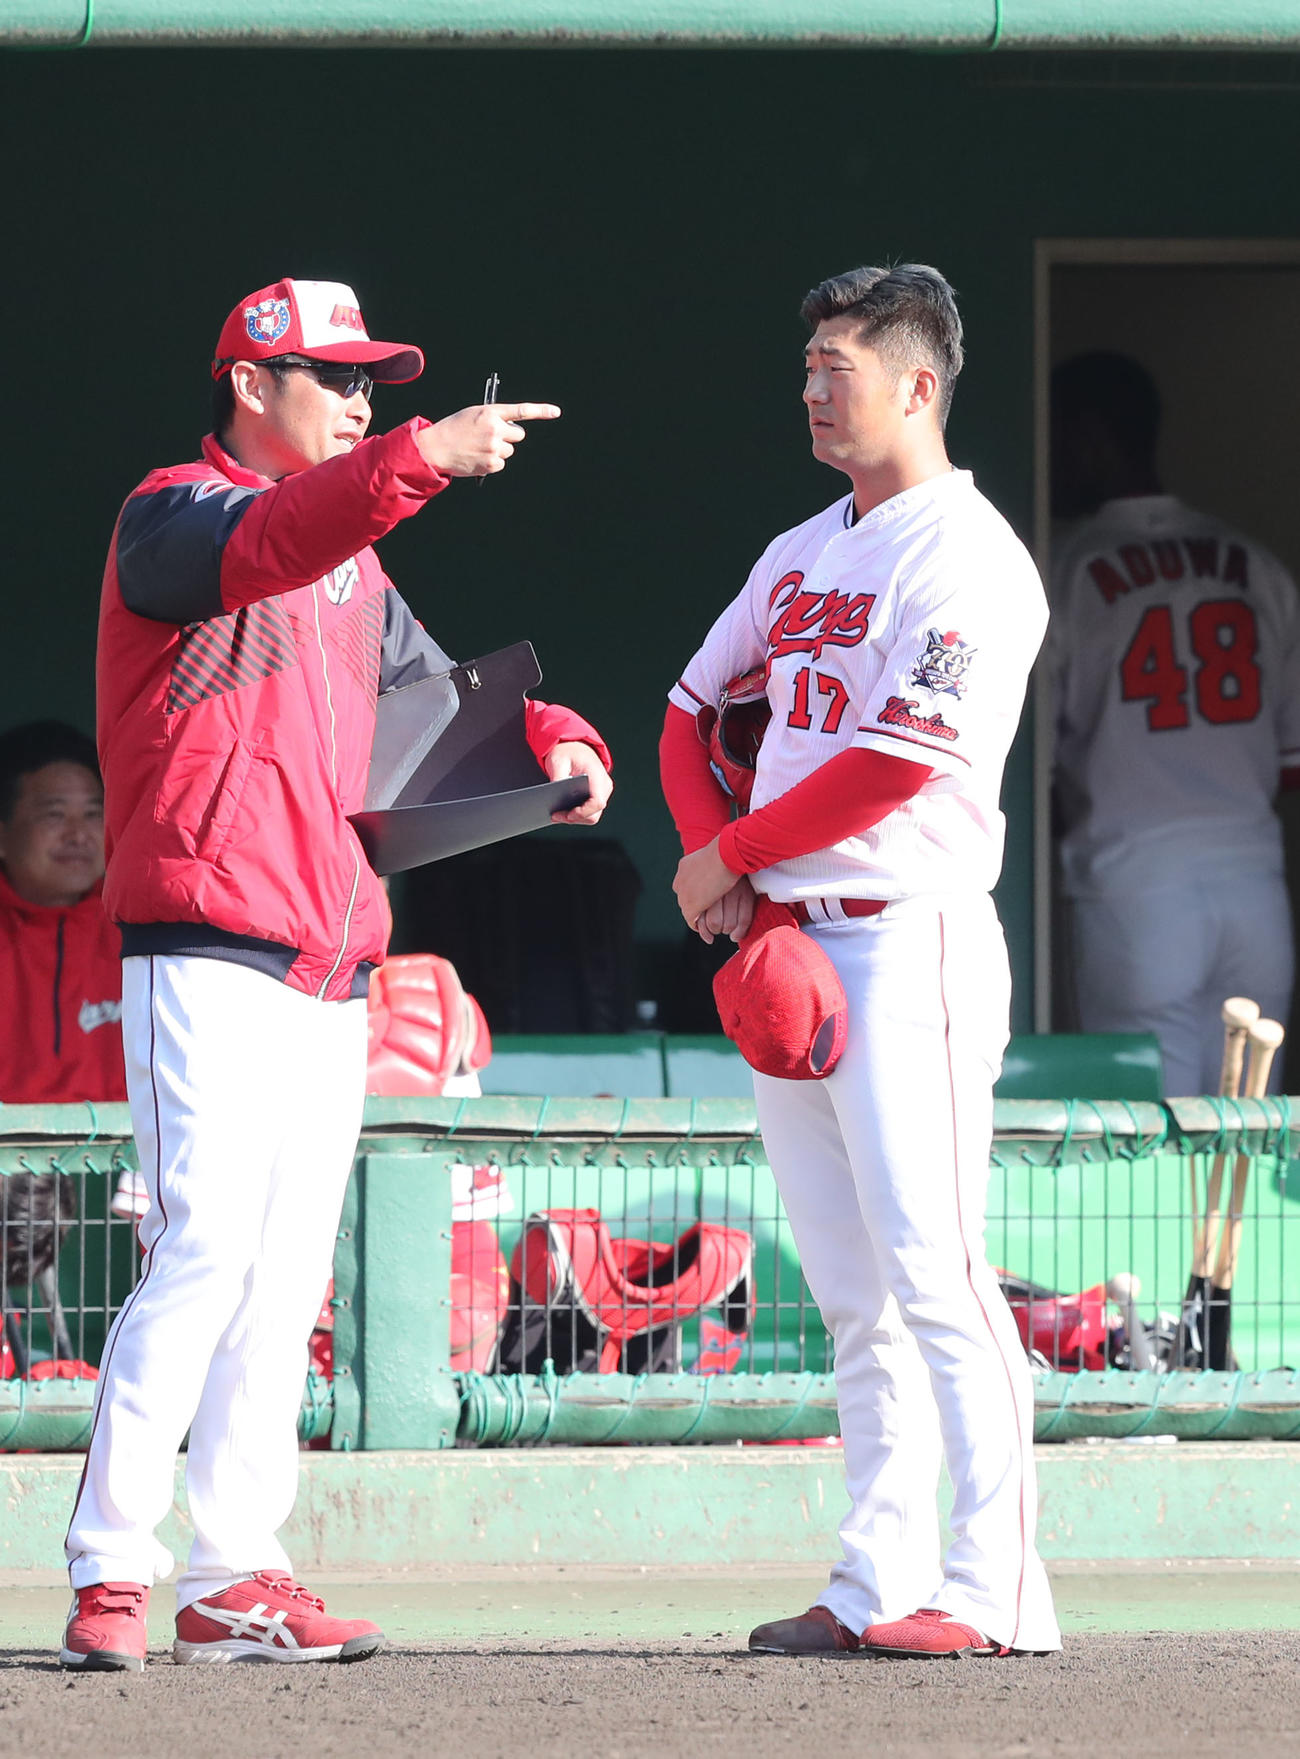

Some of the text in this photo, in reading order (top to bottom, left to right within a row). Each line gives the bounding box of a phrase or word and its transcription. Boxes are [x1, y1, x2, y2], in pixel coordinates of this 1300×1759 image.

[1087, 537, 1249, 606] ADUWA
[767, 570, 876, 663] Carp
[1120, 598, 1262, 733] 48
[787, 666, 850, 735] 17
[877, 695, 960, 742] Hiroshima
